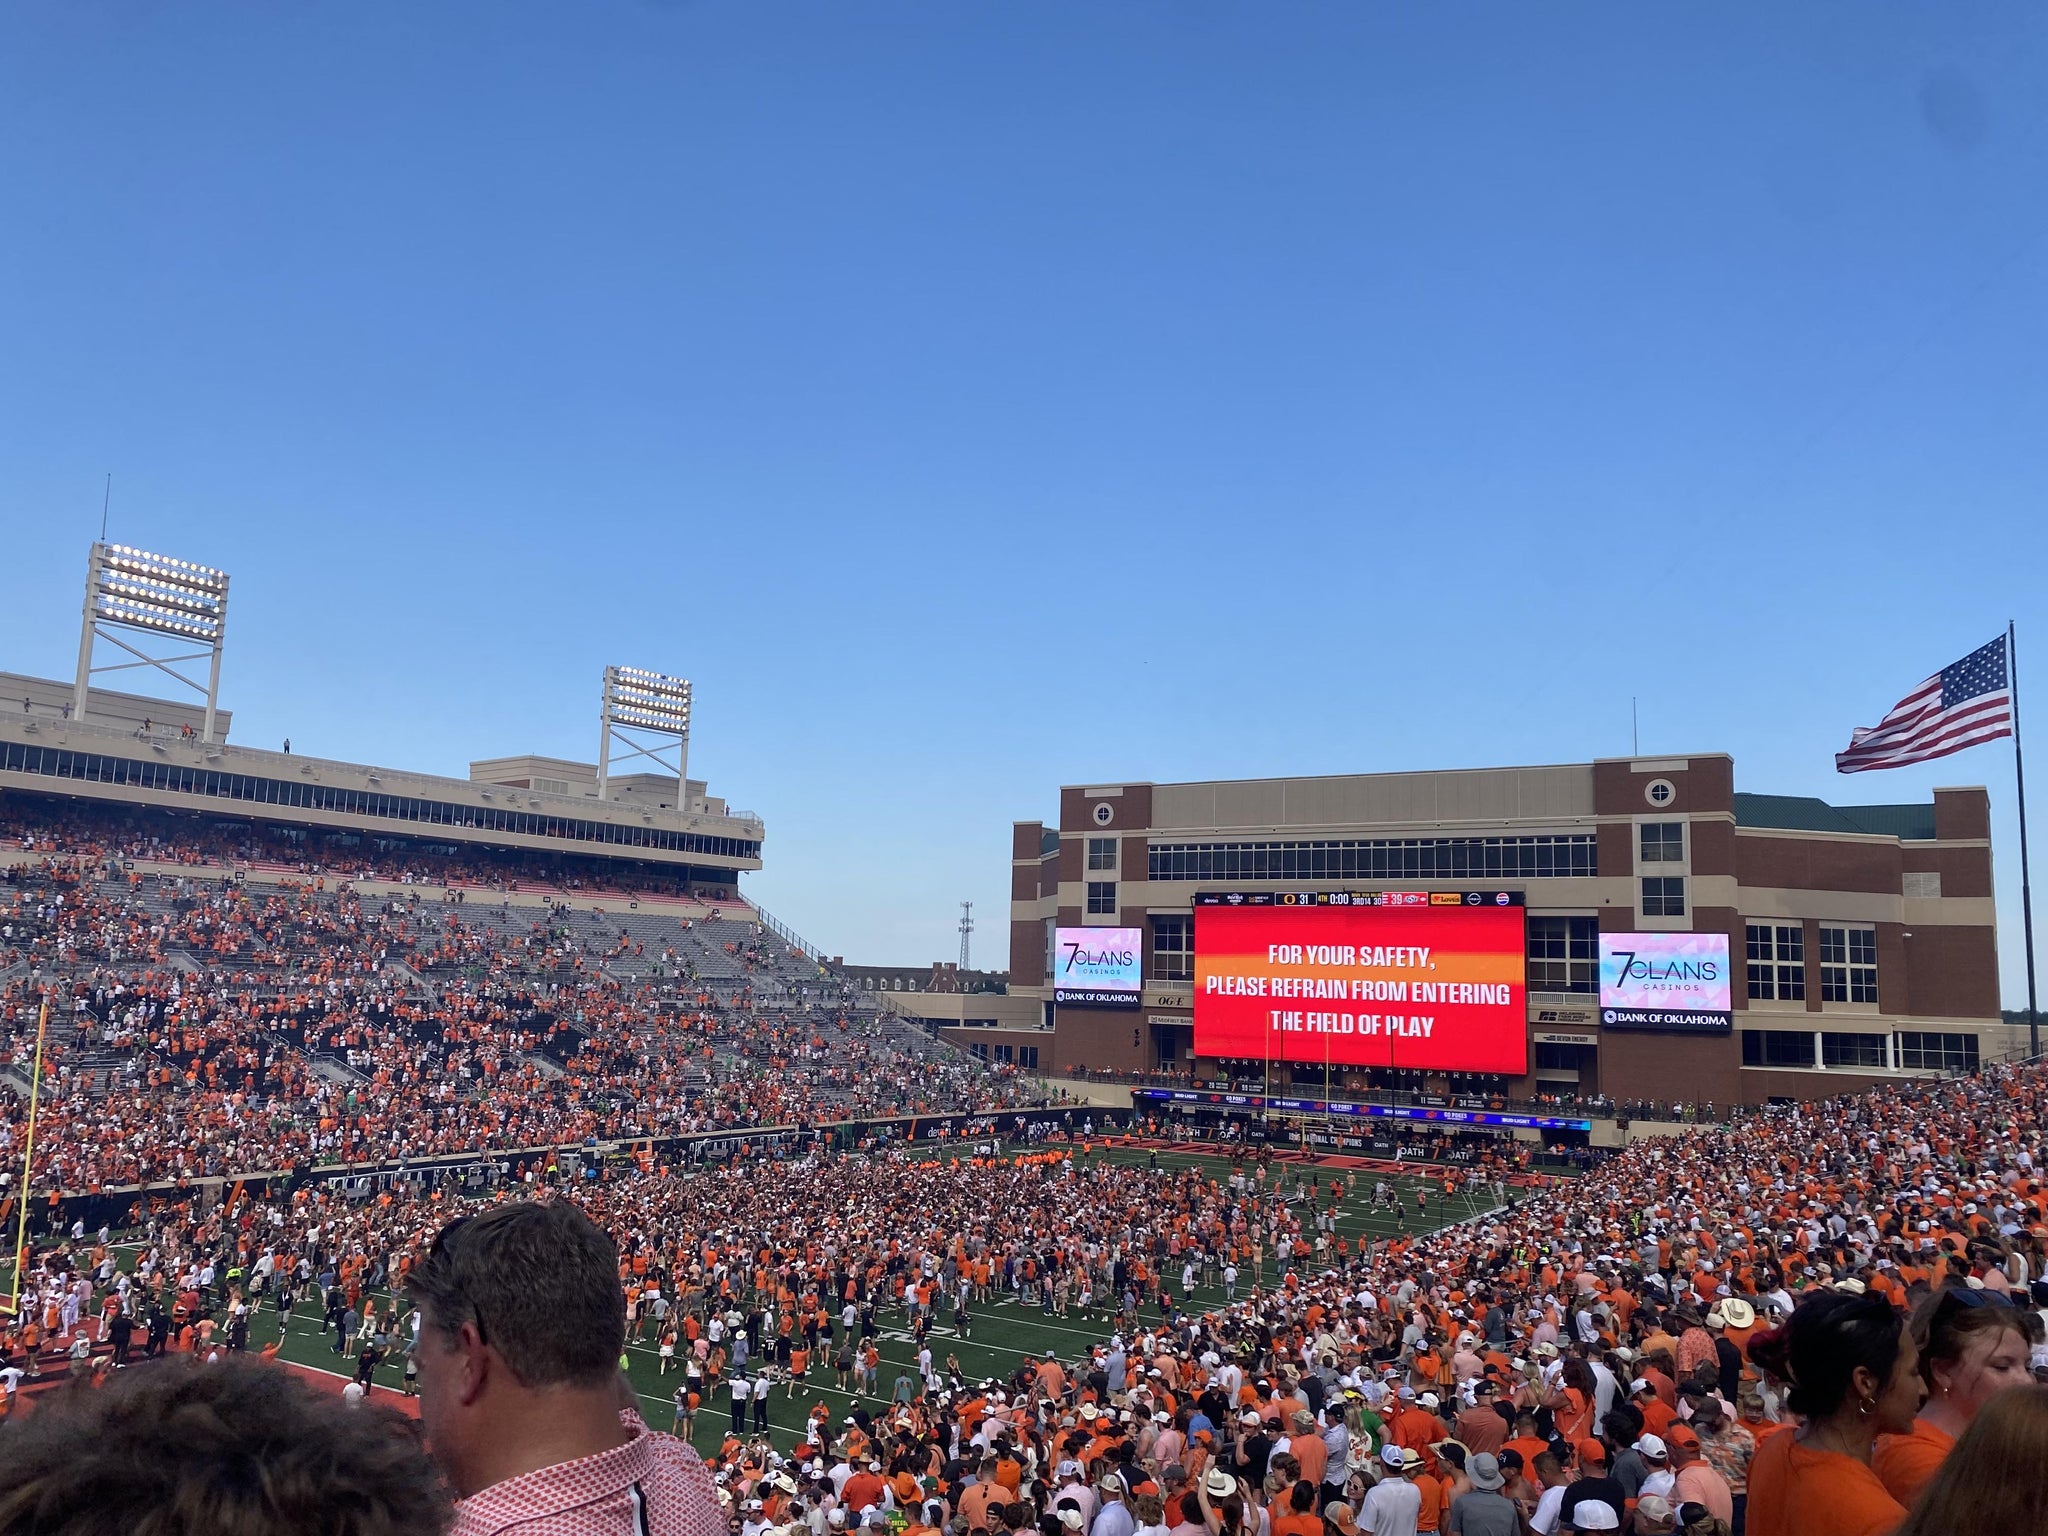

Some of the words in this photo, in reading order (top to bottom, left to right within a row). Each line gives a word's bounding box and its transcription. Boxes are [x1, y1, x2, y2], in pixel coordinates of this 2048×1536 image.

[1299, 894, 1309, 905] 31
[1317, 895, 1328, 903] 4TH
[1329, 893, 1349, 905] 0:00
[1373, 898, 1382, 906] 30
[1391, 893, 1403, 905] 39
[1268, 944, 1303, 966] FOR
[1305, 945, 1357, 967] YOUR
[1359, 946, 1437, 971] SAFETY,
[1206, 975, 1269, 997] PLEASE
[1271, 977, 1348, 1000] REFRAIN
[1351, 980, 1408, 1002] FROM
[1411, 982, 1511, 1006] ENTERING
[1643, 983, 1700, 991] CASINOS
[1065, 992, 1085, 1001] BANK
[1086, 993, 1096, 1001] OF
[1096, 994, 1138, 1003] OKLAHOMA
[1270, 1010, 1304, 1032] THE
[1306, 1012, 1355, 1034] FIELD
[1358, 1014, 1382, 1036] OF
[1385, 1016, 1435, 1038] PLAY
[1617, 1012, 1649, 1023] BANK
[1649, 1013, 1663, 1024] OF
[1664, 1014, 1728, 1026] OKLAHOMA
[1219, 1058, 1260, 1067] GARY
[1273, 1060, 1280, 1068] &
[1293, 1062, 1372, 1074] CLAUDIA
[1386, 1067, 1500, 1082] HUMPHREYS
[1399, 1146, 1425, 1157] OATH
[767, 1342, 775, 1351] 17
